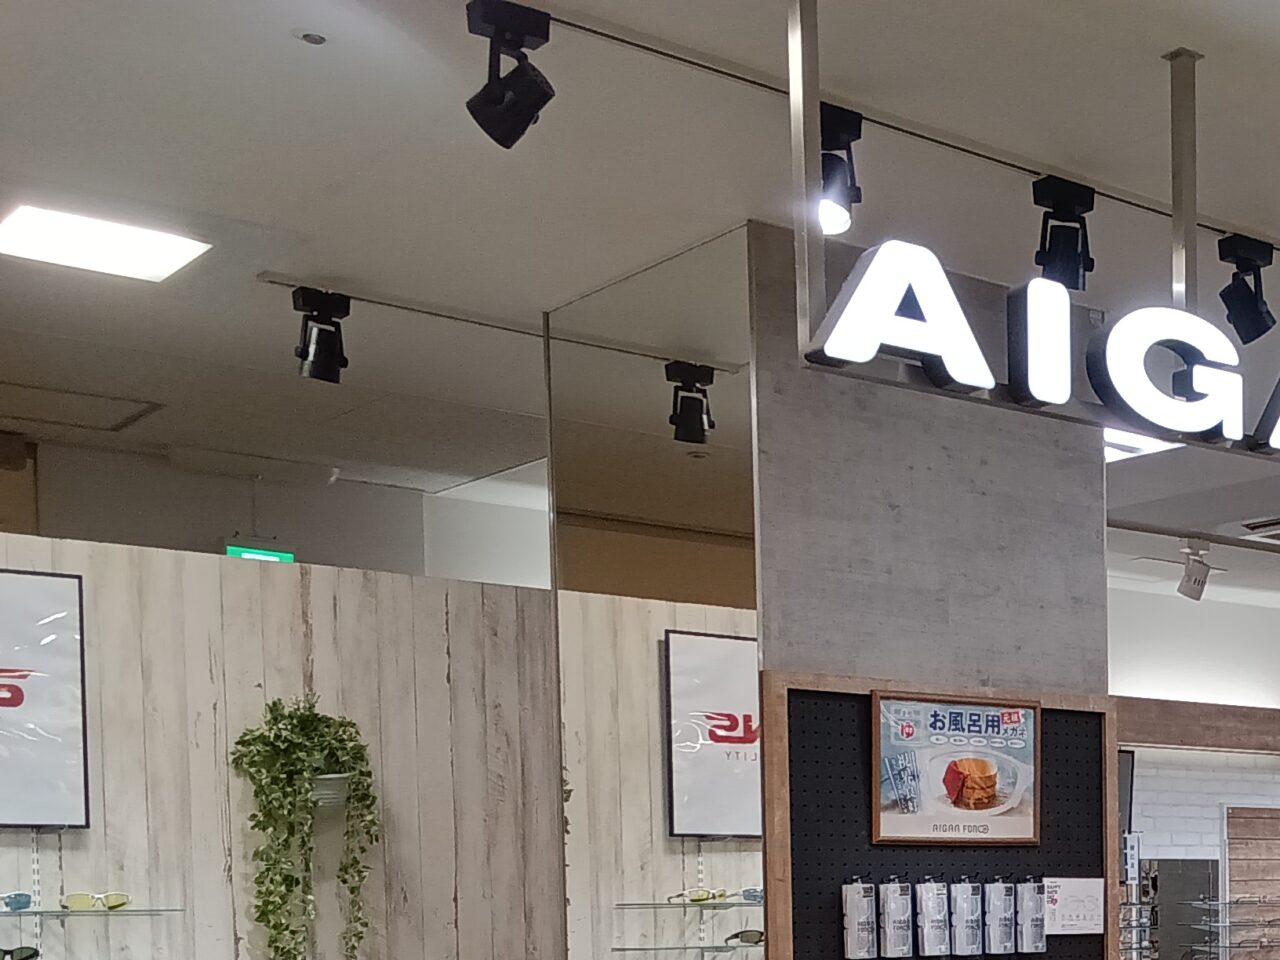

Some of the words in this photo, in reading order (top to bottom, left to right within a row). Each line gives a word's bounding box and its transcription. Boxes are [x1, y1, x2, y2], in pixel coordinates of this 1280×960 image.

[928, 709, 1002, 735] お風呂用
[1002, 728, 1027, 738] メガネ
[932, 823, 960, 833] AIGAN
